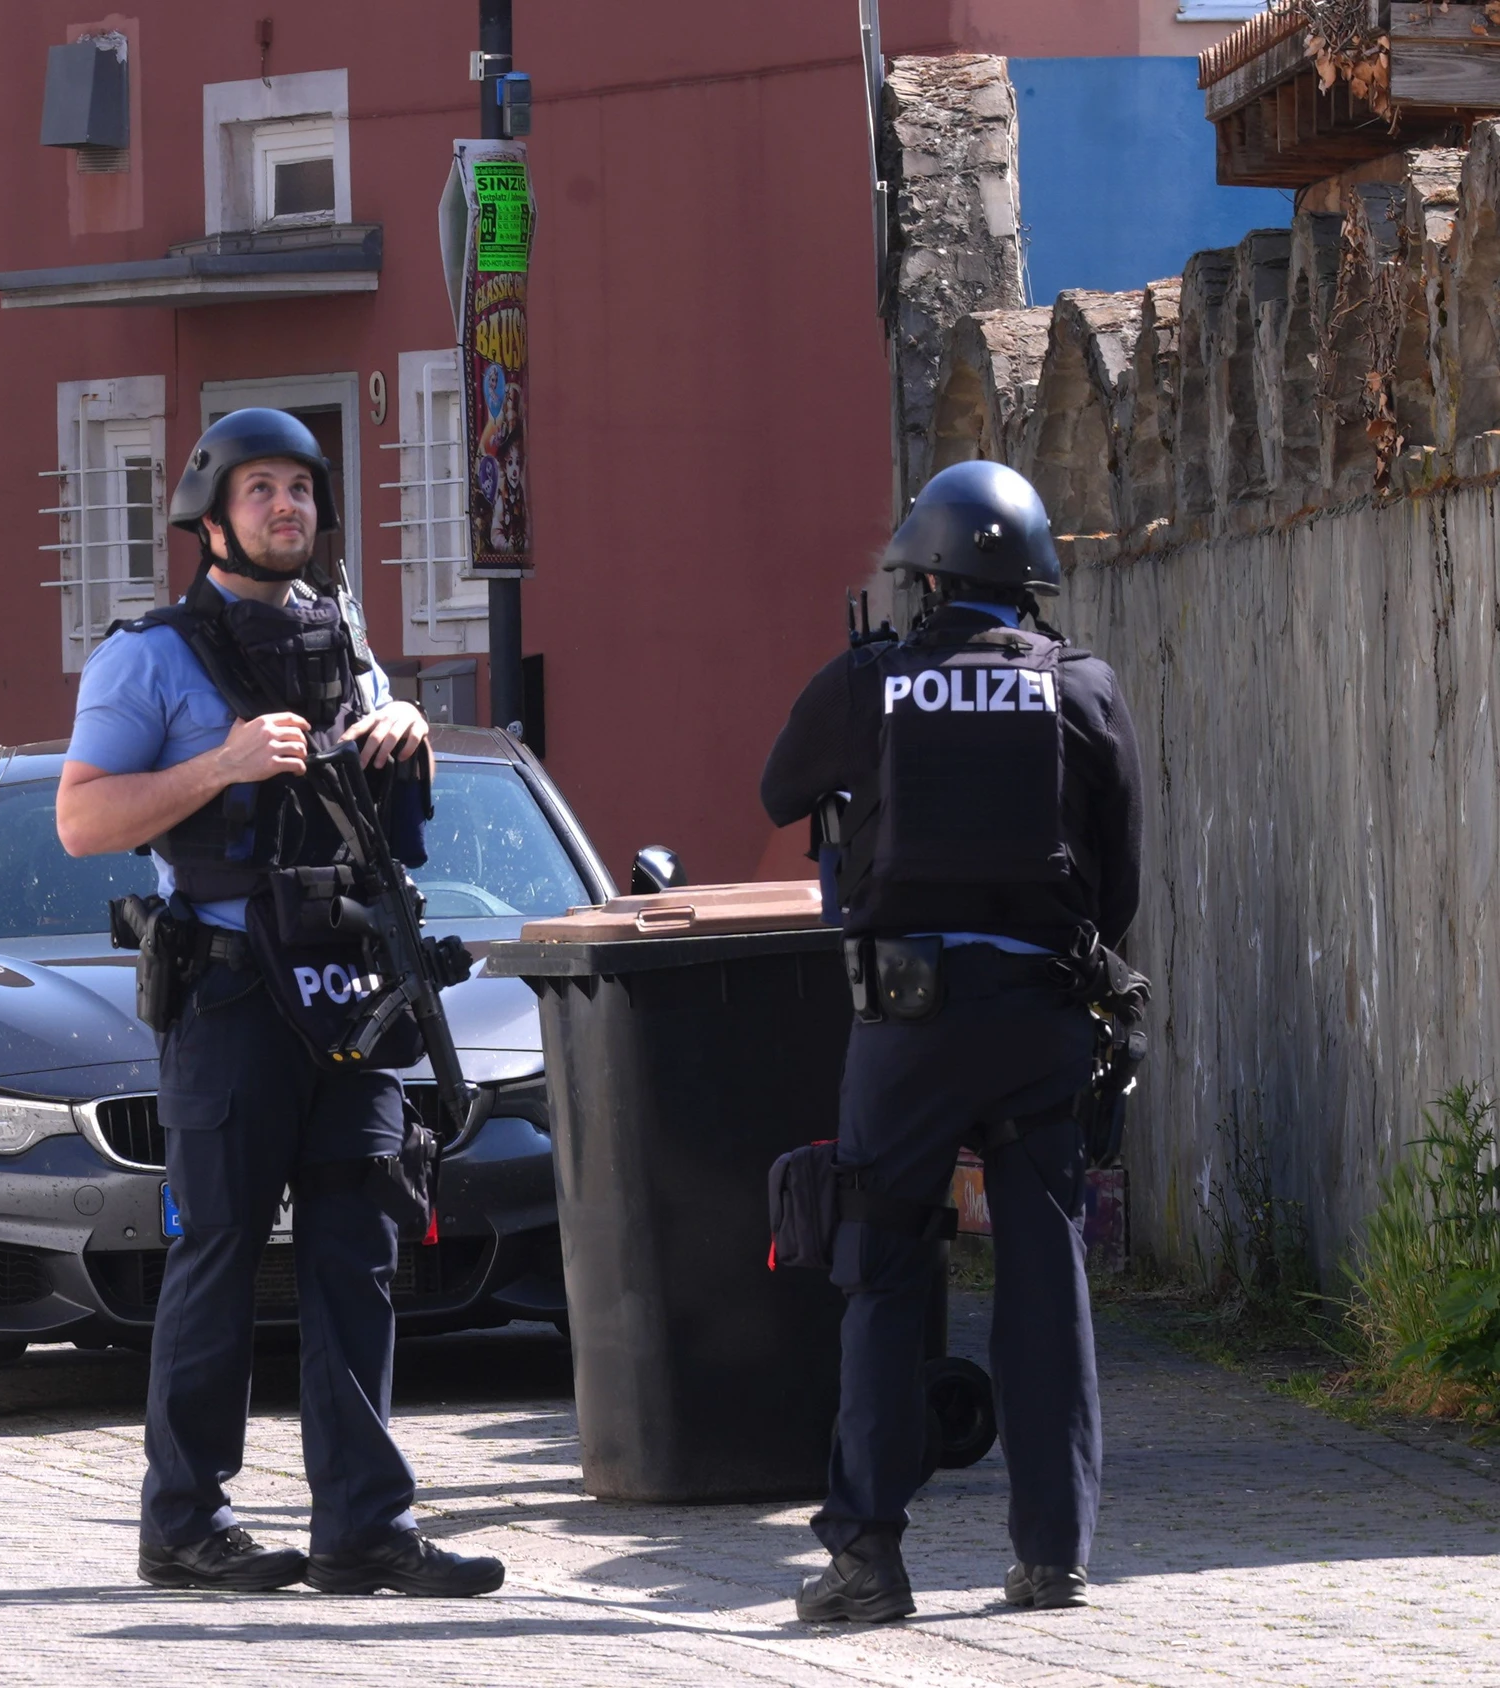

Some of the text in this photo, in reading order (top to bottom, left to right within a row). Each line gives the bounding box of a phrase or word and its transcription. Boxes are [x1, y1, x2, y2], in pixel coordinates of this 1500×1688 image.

[477, 177, 526, 192] SINZIG
[482, 218, 496, 233] 01.
[475, 273, 513, 315] CLASSIC
[369, 370, 387, 425] 9
[884, 669, 1057, 714] POLIZEI
